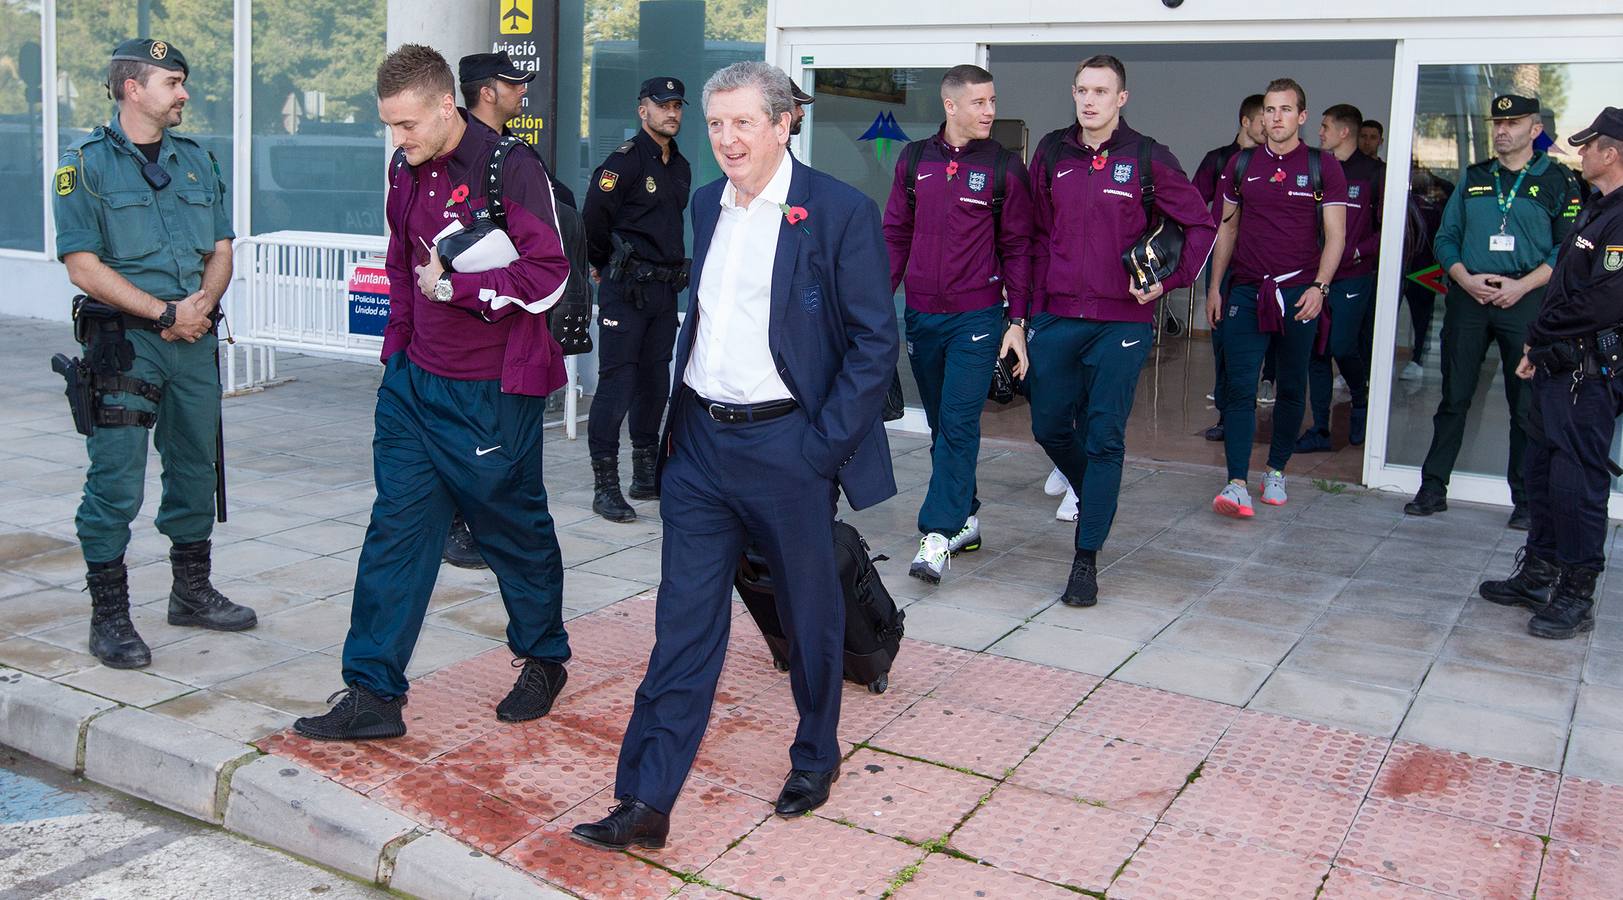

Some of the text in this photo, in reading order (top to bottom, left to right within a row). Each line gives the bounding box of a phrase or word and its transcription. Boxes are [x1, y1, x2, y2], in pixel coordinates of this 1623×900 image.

[492, 41, 537, 56] Aviació
[512, 57, 540, 72] eral
[505, 114, 544, 129] ación
[376, 296, 391, 306] Loca
